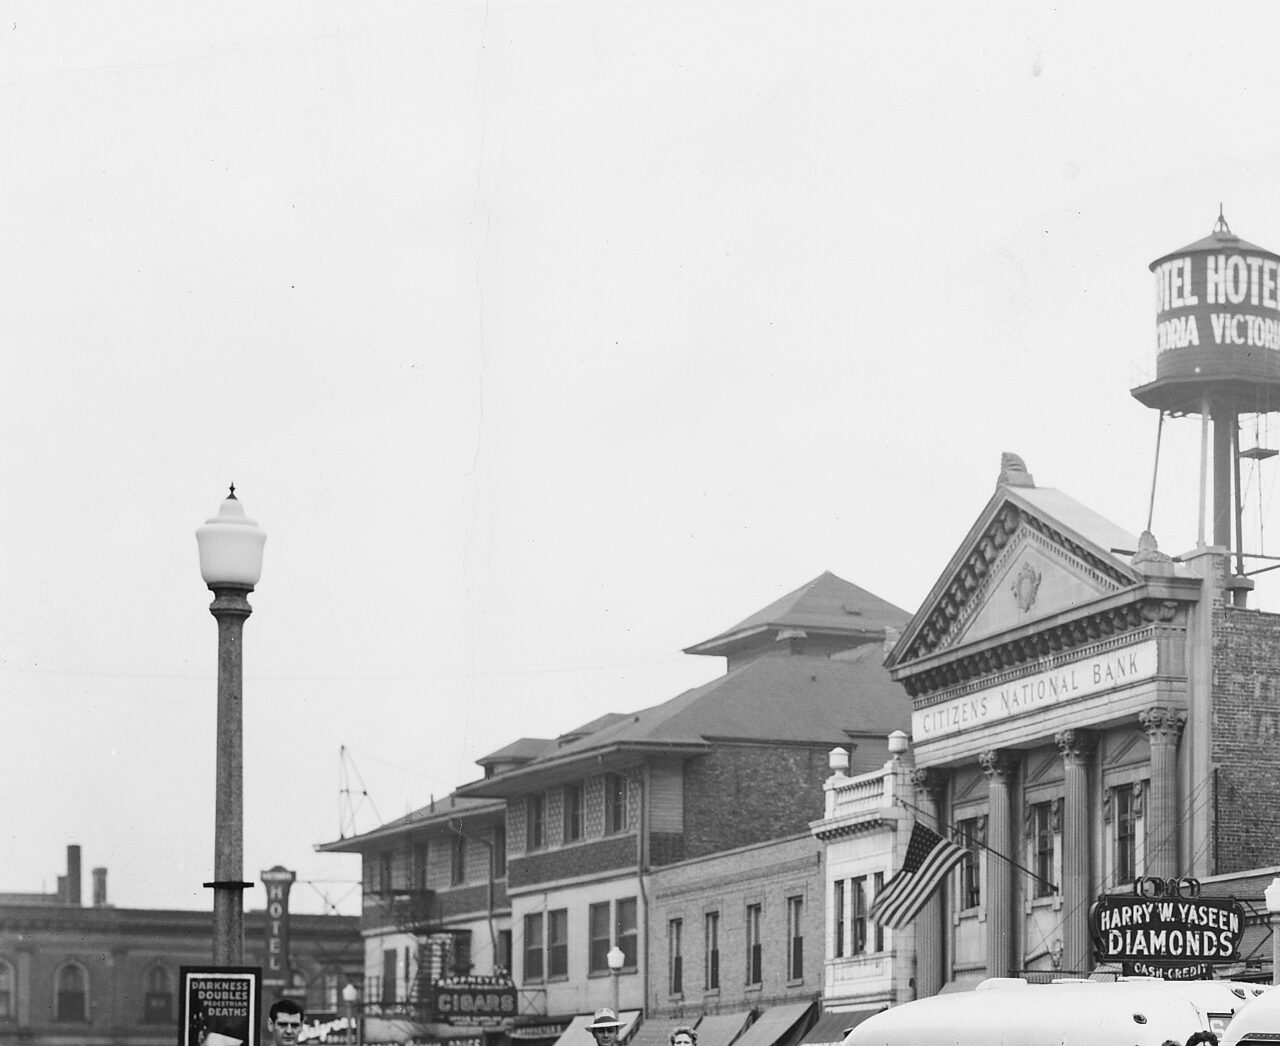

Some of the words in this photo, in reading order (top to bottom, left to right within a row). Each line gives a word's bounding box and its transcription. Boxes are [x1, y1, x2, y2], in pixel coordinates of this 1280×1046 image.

[922, 697, 988, 733] CITIZENS
[1000, 669, 1079, 713] NATIONAL
[1092, 652, 1138, 684] BANK
[269, 884, 284, 971] HOTEL
[1101, 904, 1153, 931] HARRY
[1155, 902, 1175, 922] W.
[1178, 903, 1239, 933] YASEEN
[1108, 929, 1233, 956] DIAMONDS
[191, 981, 248, 990] DARKNESS
[198, 991, 248, 1000] DOUBLES
[208, 1007, 247, 1017] DEATHS
[438, 993, 513, 1012] CIGARS
